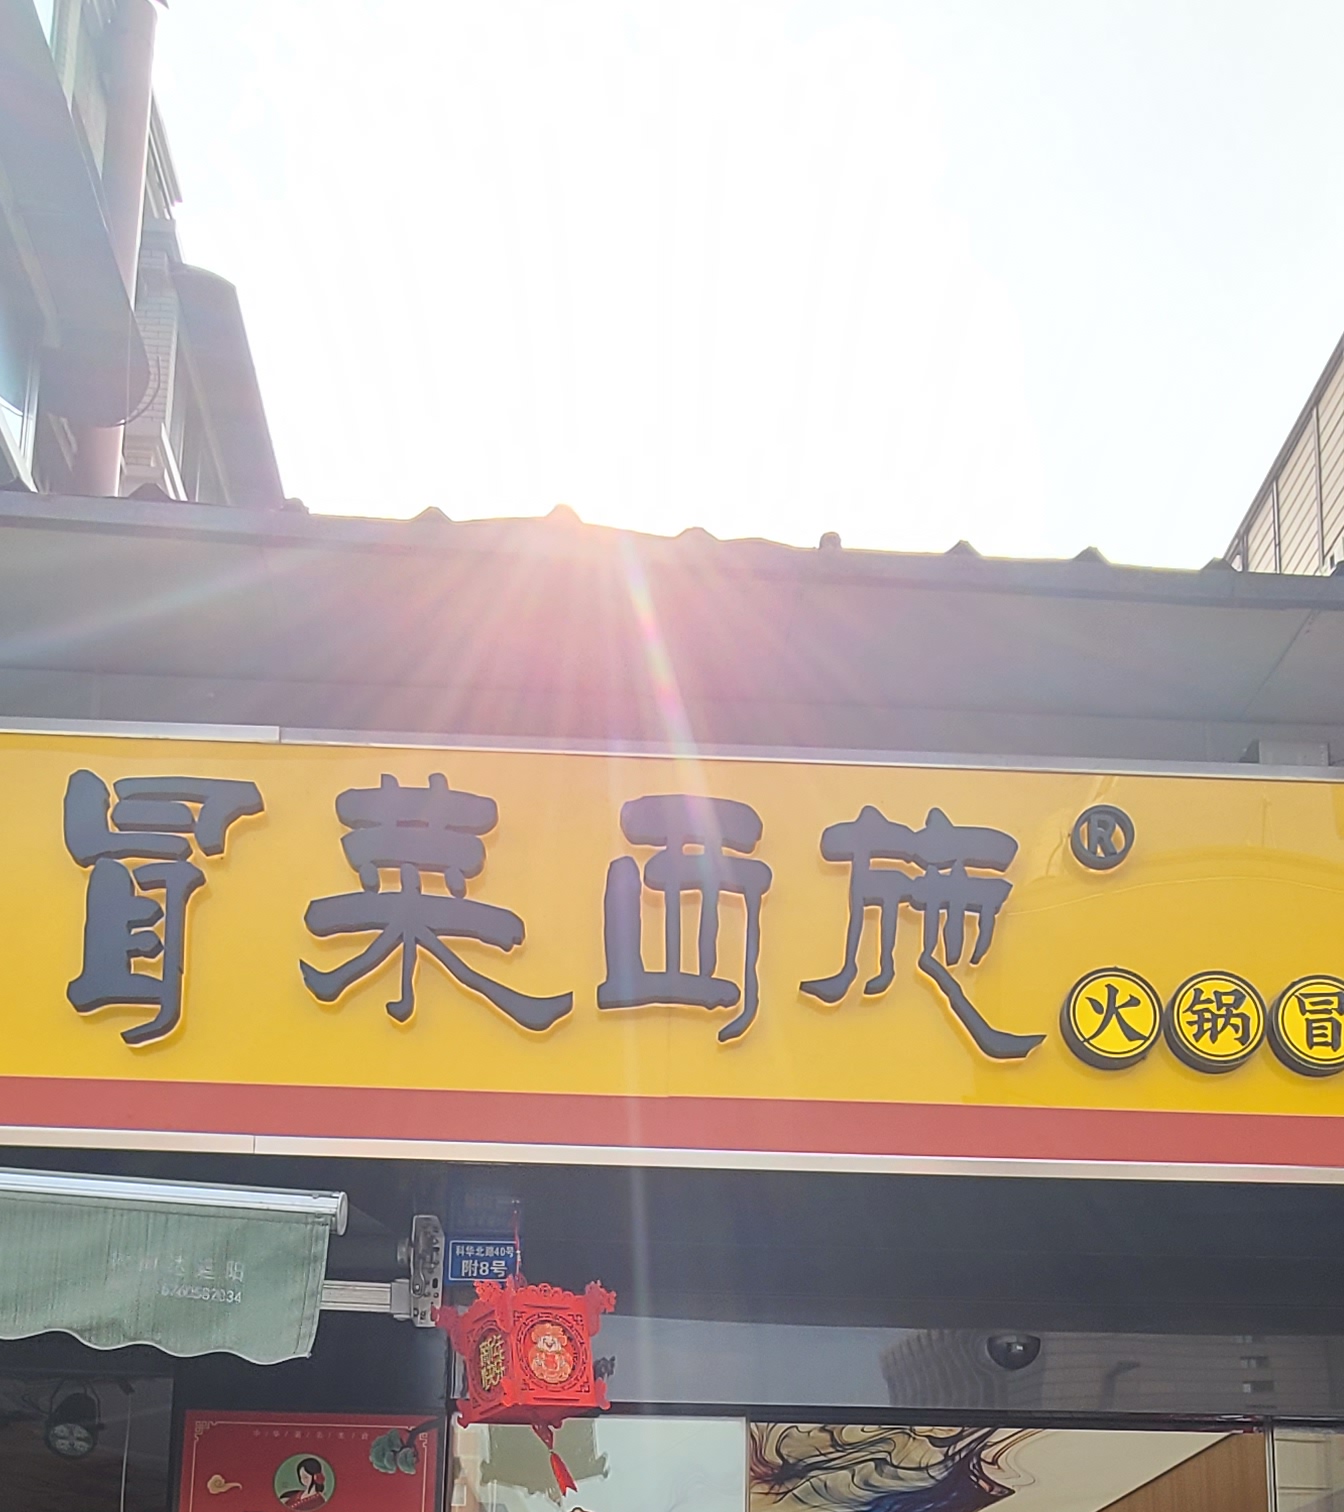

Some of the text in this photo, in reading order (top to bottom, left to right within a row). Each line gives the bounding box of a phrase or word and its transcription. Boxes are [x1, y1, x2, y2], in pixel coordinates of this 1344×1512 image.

[64, 768, 1048, 1060] 冒菜西施
[456, 1246, 514, 1258] 科华北路40号
[461, 1260, 507, 1277] 附8号
